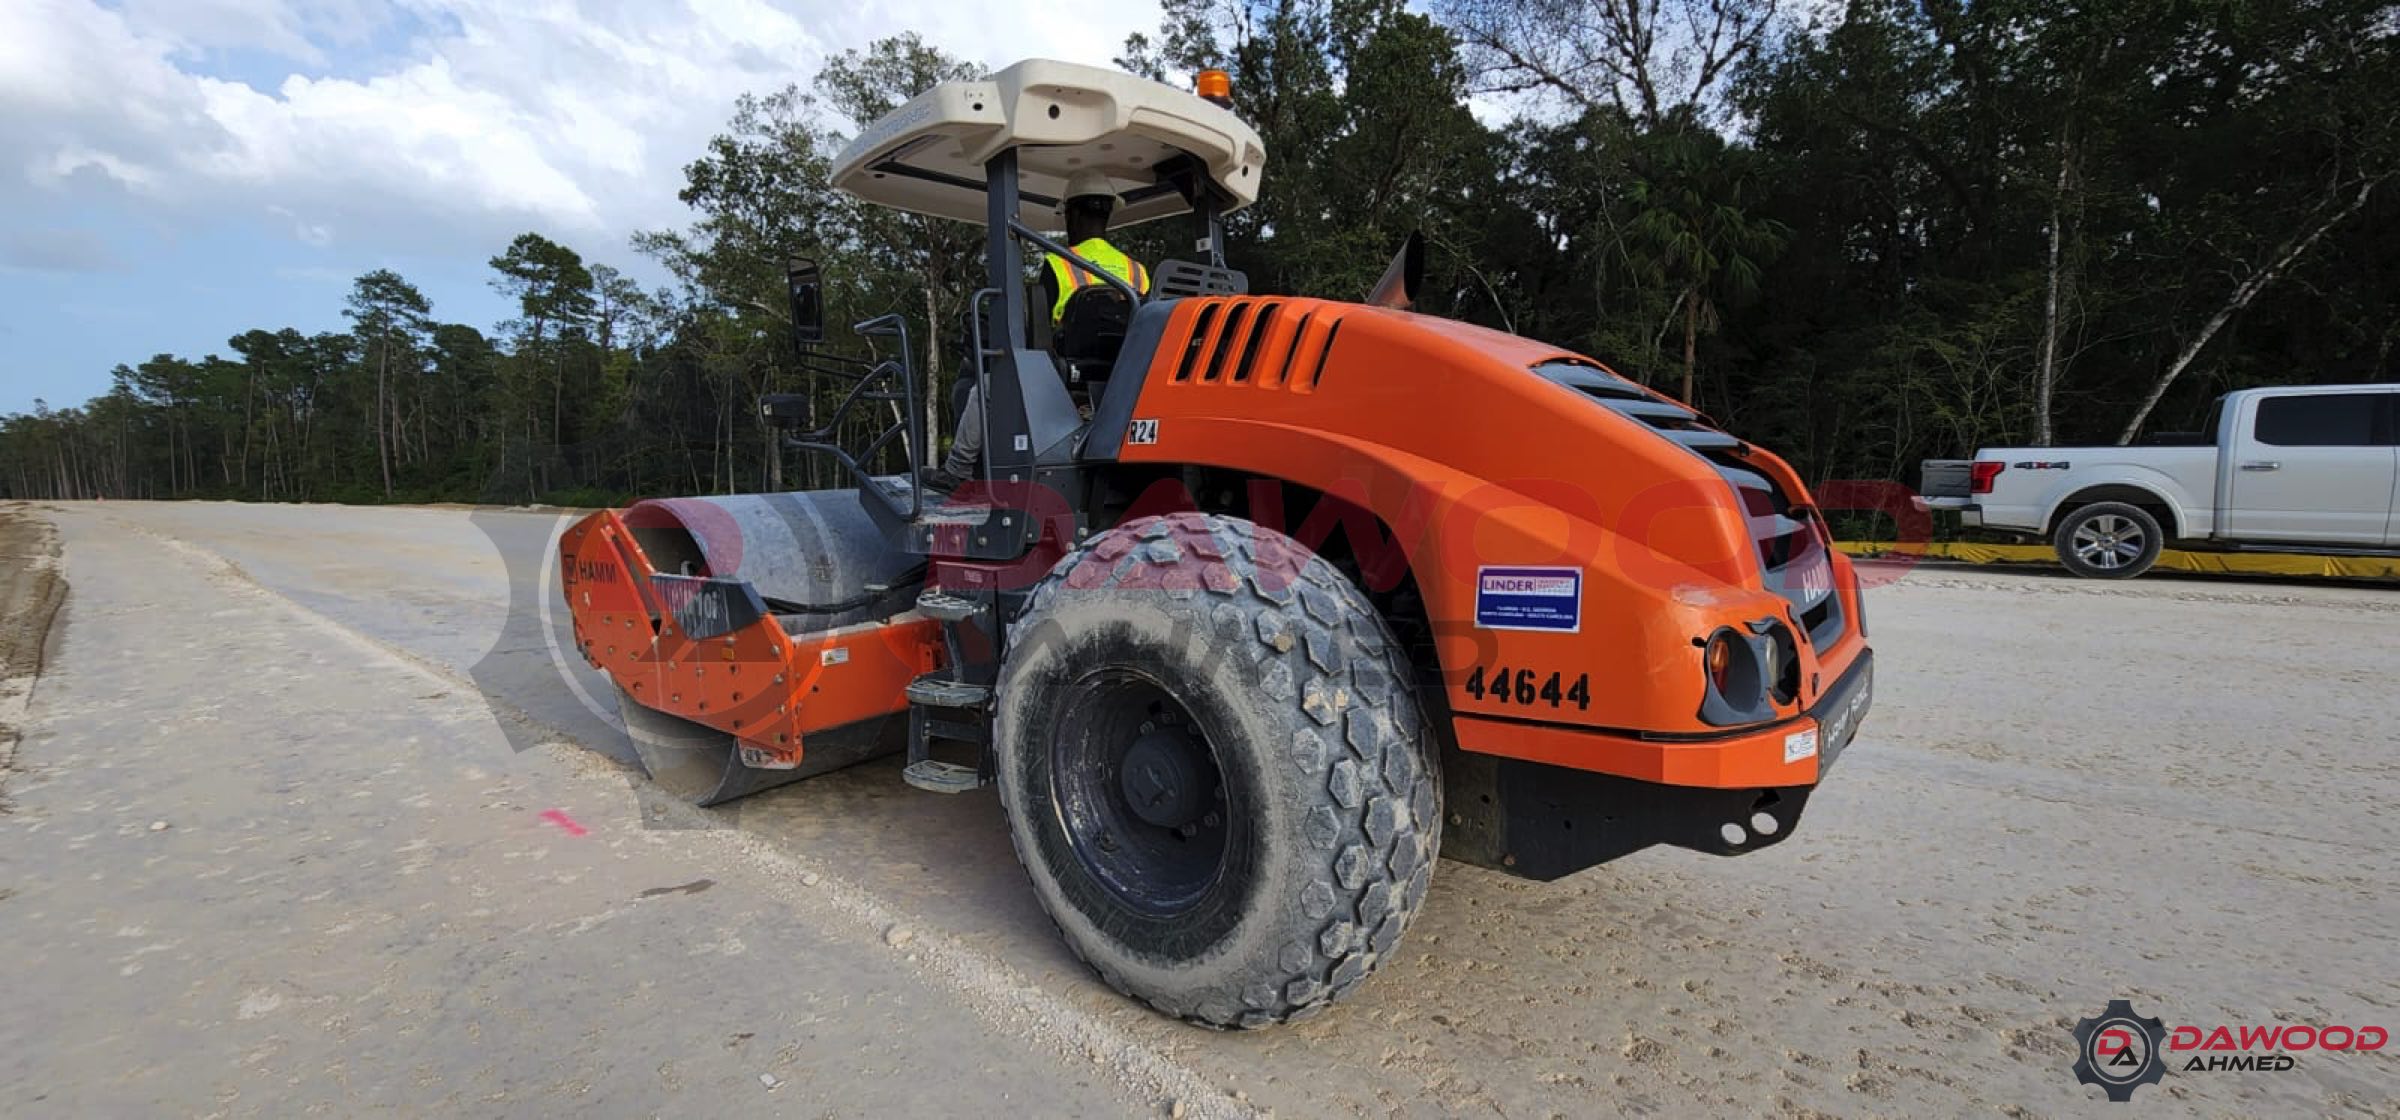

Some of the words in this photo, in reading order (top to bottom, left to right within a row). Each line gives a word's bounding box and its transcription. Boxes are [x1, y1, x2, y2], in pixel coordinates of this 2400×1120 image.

[1129, 420, 1156, 443] R24
[578, 560, 616, 584] HAMM
[1484, 579, 1534, 592] LINDER
[1465, 666, 1591, 711] 44644
